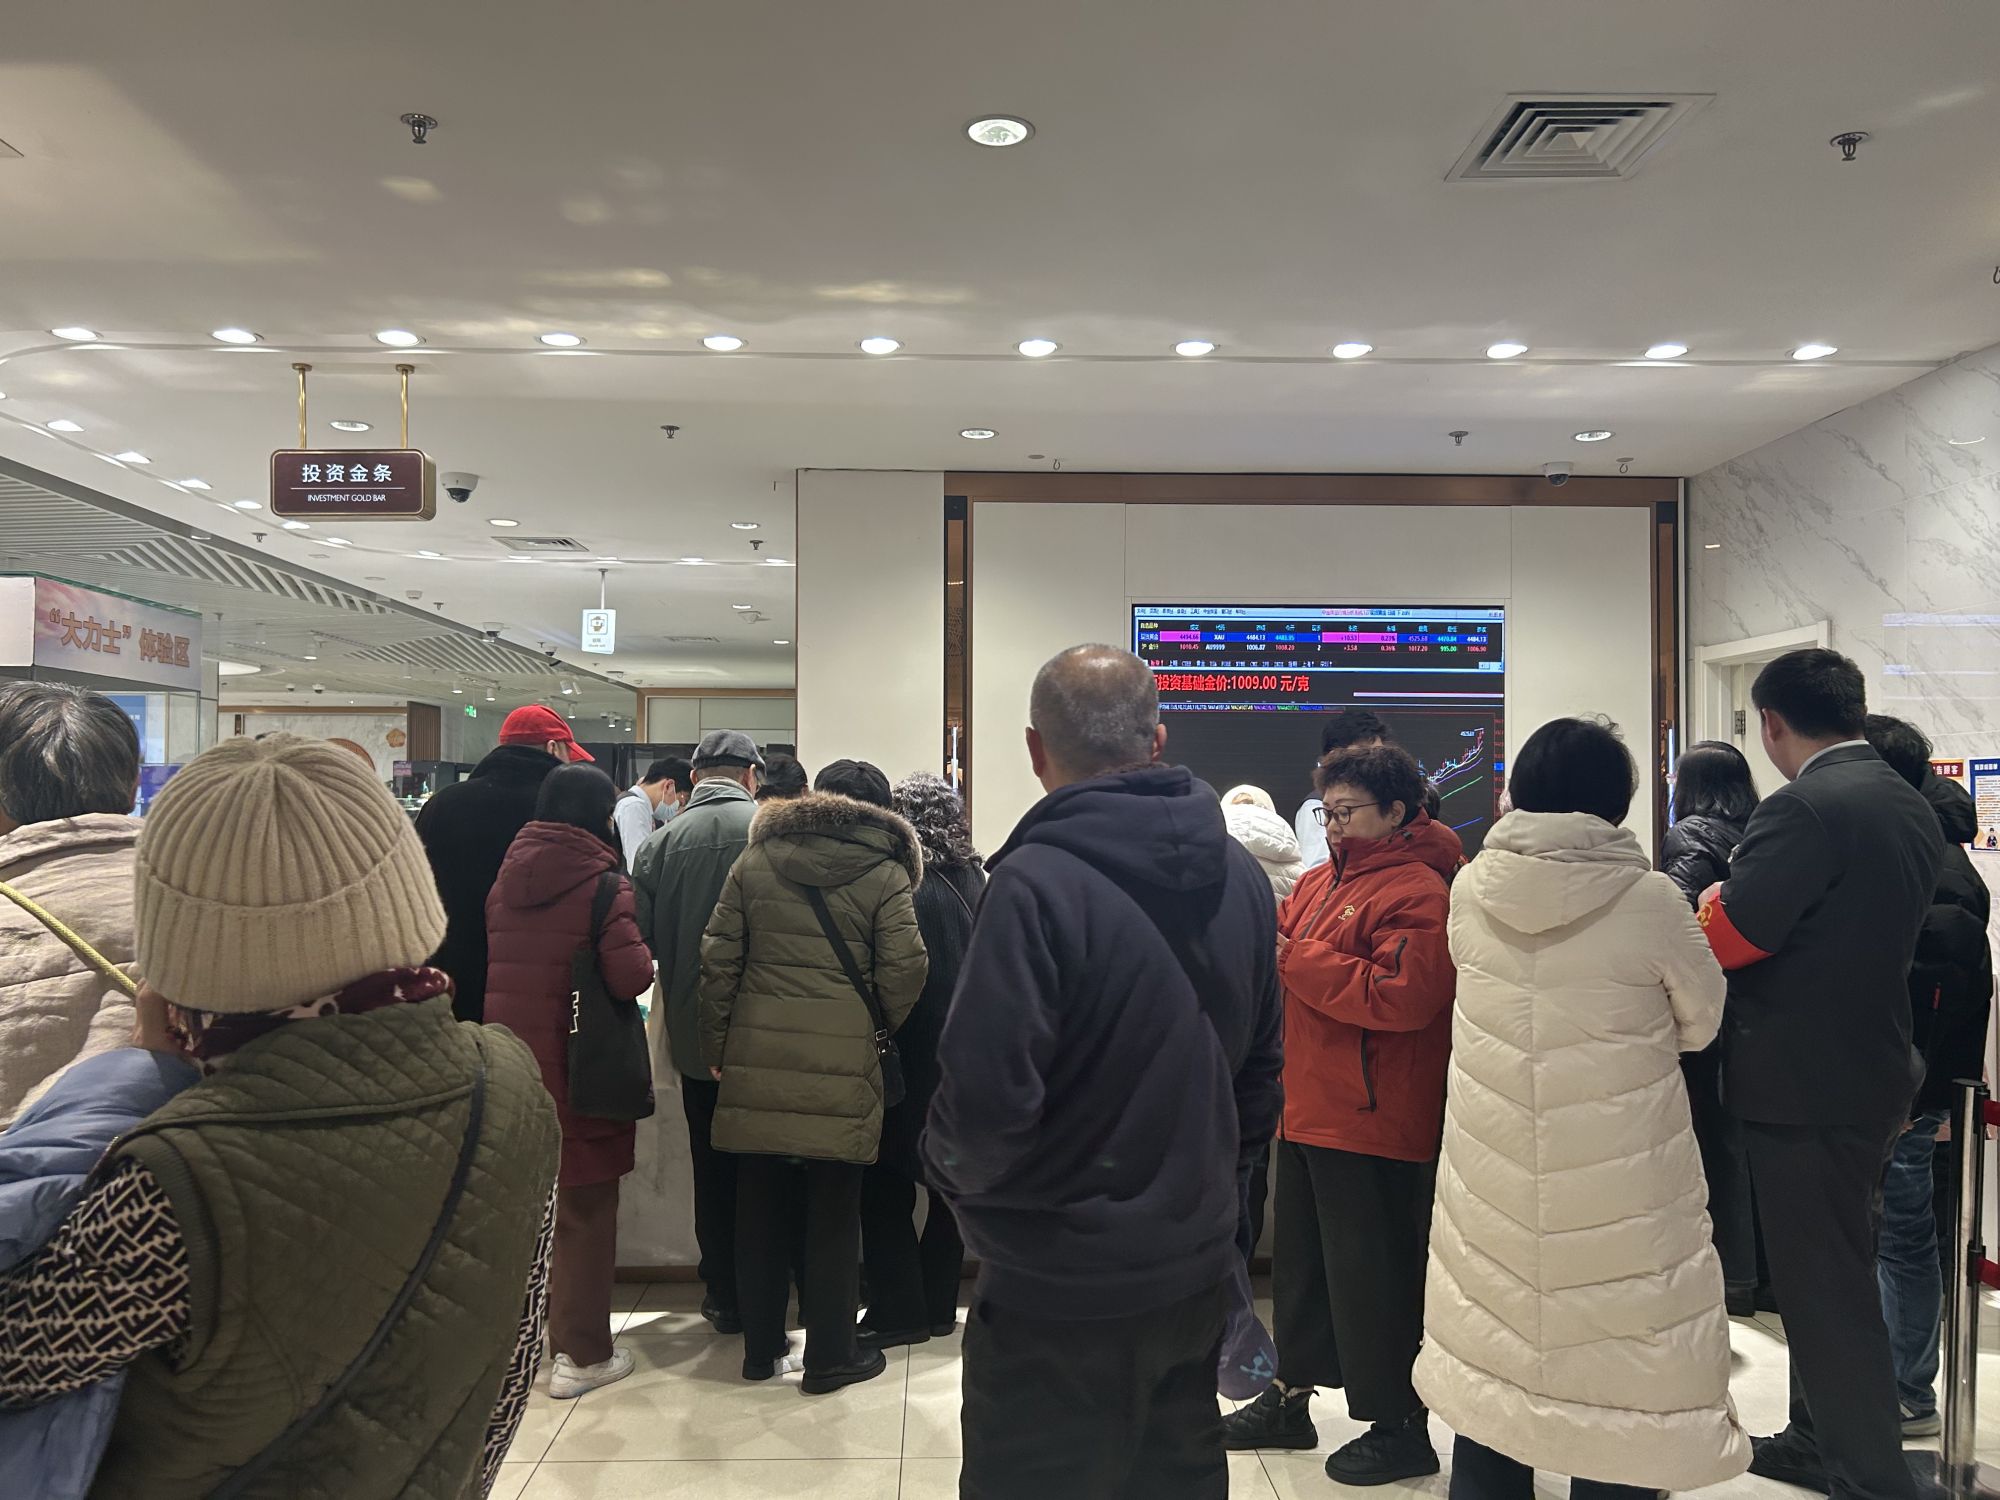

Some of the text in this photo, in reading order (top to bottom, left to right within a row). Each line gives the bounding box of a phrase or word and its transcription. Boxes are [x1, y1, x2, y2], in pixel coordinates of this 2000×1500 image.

[302, 463, 392, 483] 投资金条
[307, 494, 387, 502] INVESTMENT GOLD BAR
[1280, 675, 1310, 692] 元/克
[1933, 765, 1959, 775] 告顾客
